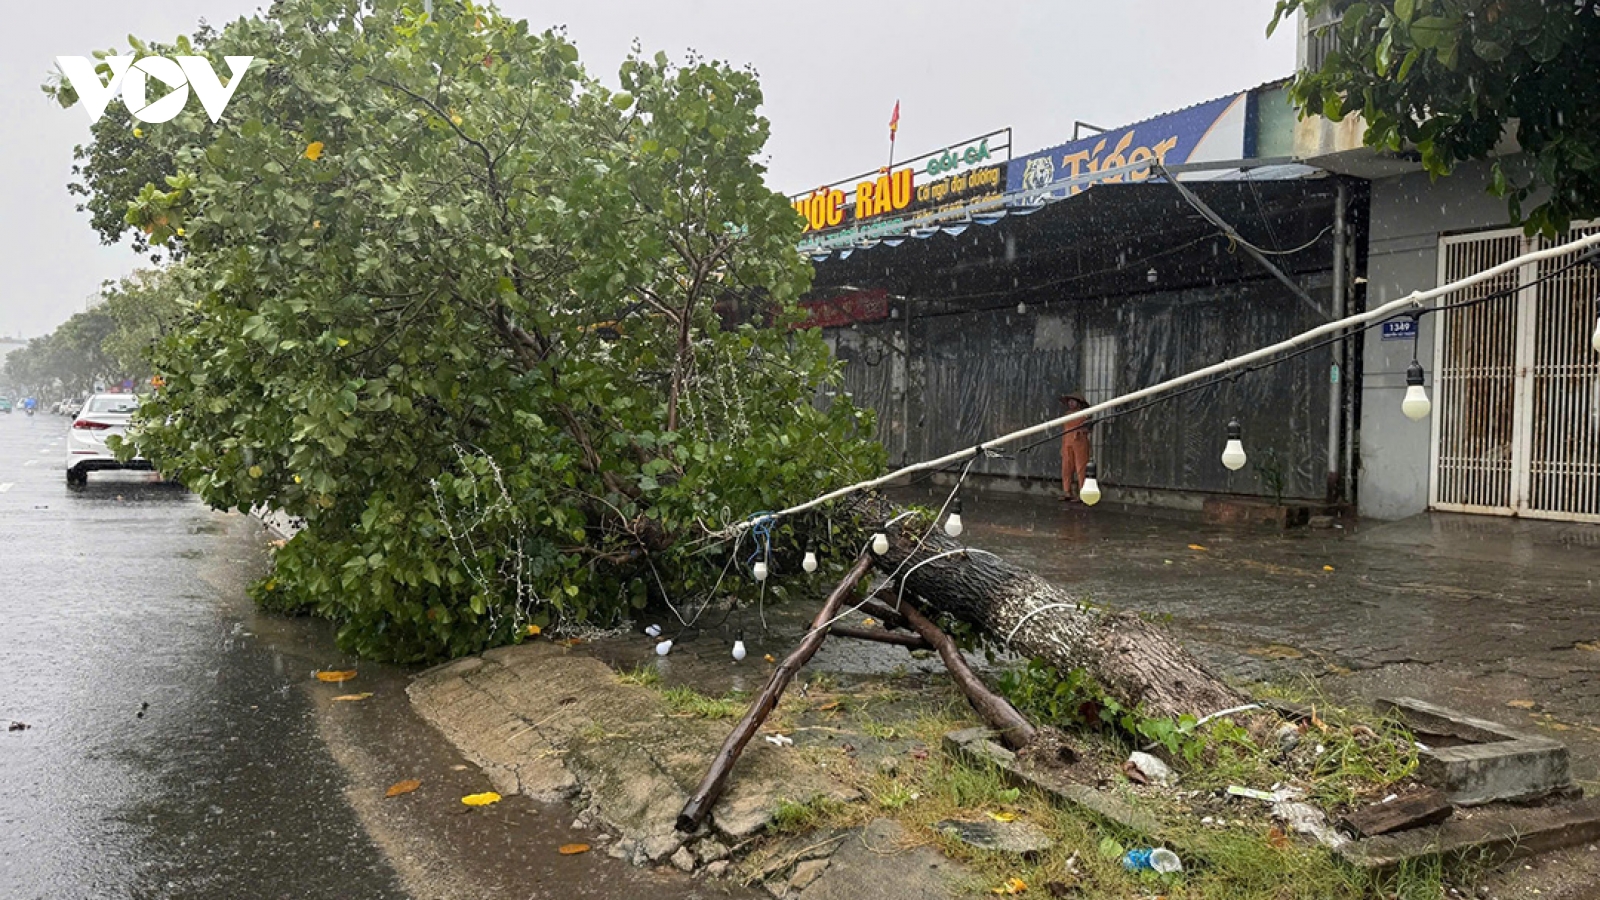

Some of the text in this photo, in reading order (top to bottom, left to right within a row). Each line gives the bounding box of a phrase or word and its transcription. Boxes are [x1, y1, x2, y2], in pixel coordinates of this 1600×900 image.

[1062, 130, 1178, 195] Tiger
[790, 185, 846, 234] ƯỚC
[1389, 323, 1410, 332] 1349
